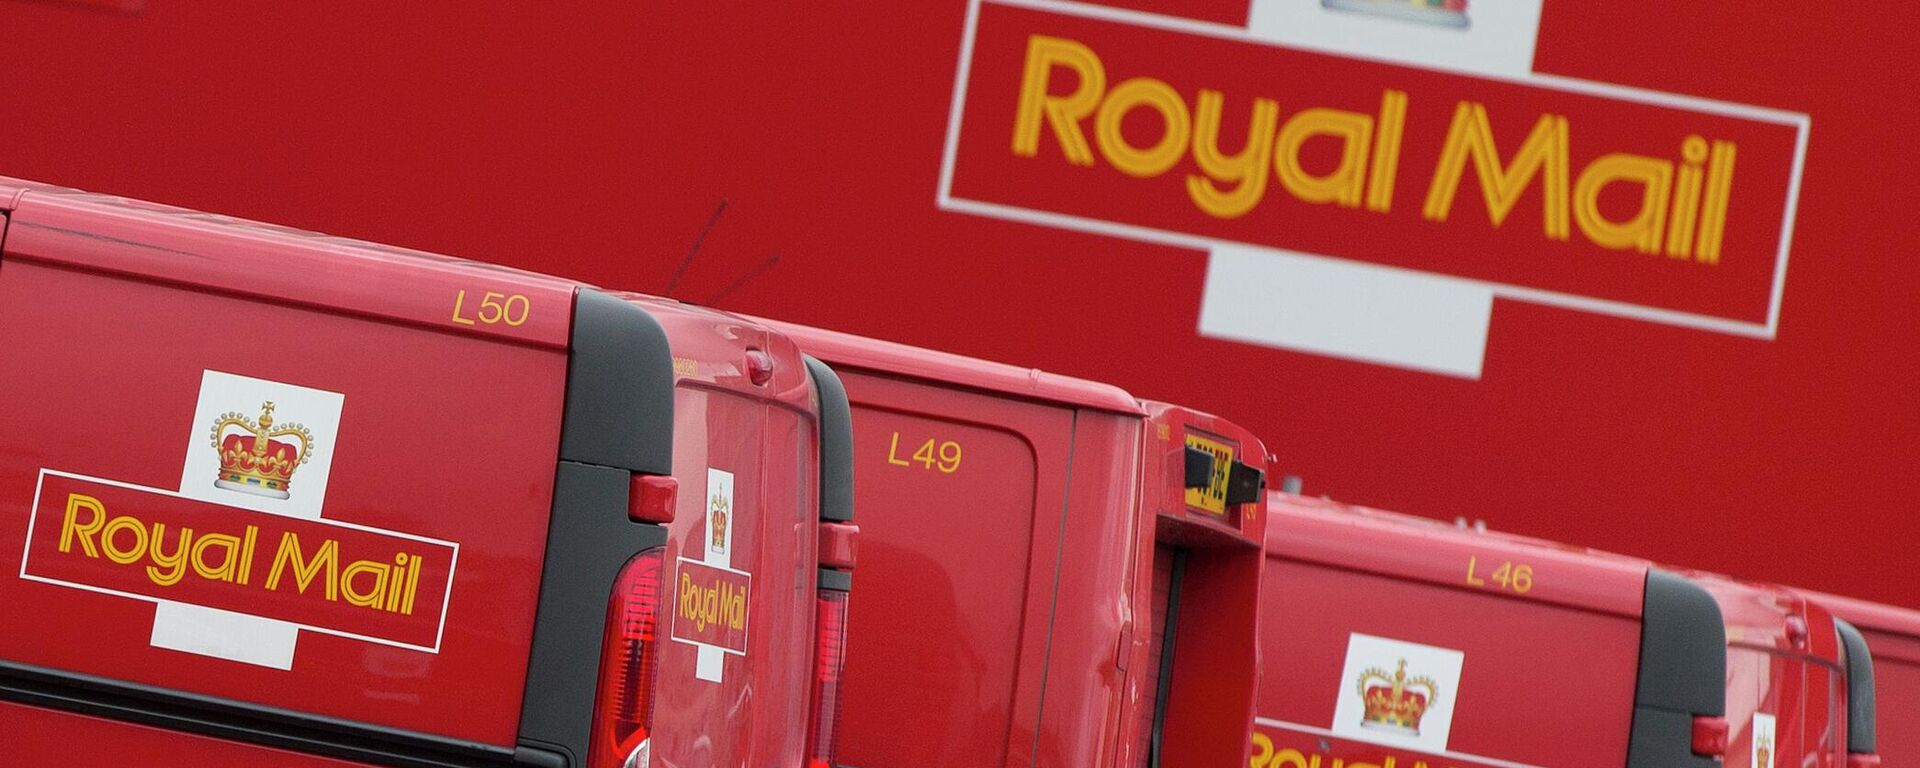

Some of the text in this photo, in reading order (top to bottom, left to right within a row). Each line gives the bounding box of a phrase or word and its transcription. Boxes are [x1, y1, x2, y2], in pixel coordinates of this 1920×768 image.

[1013, 36, 1736, 263] Royal Mail
[452, 290, 529, 326] L50
[888, 431, 962, 473] L49
[58, 492, 423, 615] Royal Mail
[680, 573, 745, 632] Royal Mail
